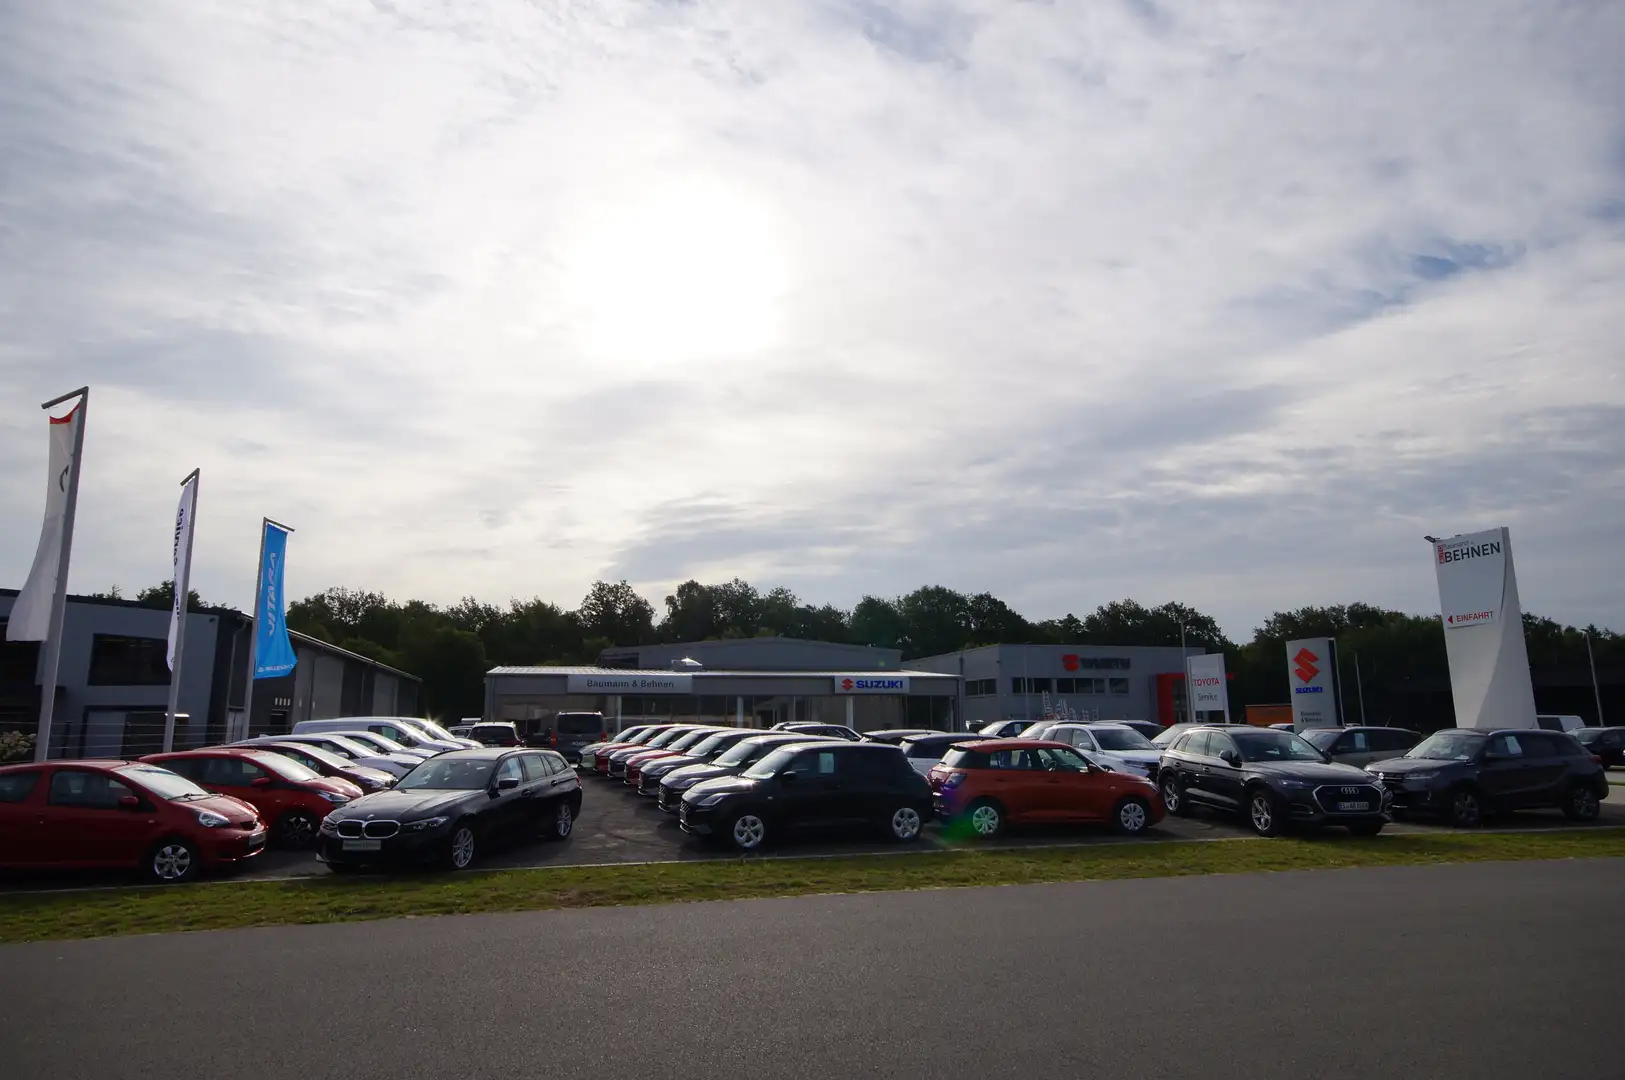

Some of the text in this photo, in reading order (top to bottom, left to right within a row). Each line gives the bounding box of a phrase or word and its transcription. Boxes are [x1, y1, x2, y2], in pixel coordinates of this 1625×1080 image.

[1444, 542, 1501, 563] BEHNEN
[267, 551, 277, 637] VITARA
[1456, 611, 1494, 622] EINFAHRT
[586, 679, 675, 689] Baumann & Behnen
[856, 679, 904, 689] SUZUKI
[1193, 677, 1220, 687] TOYOTA
[1197, 692, 1218, 701] Service
